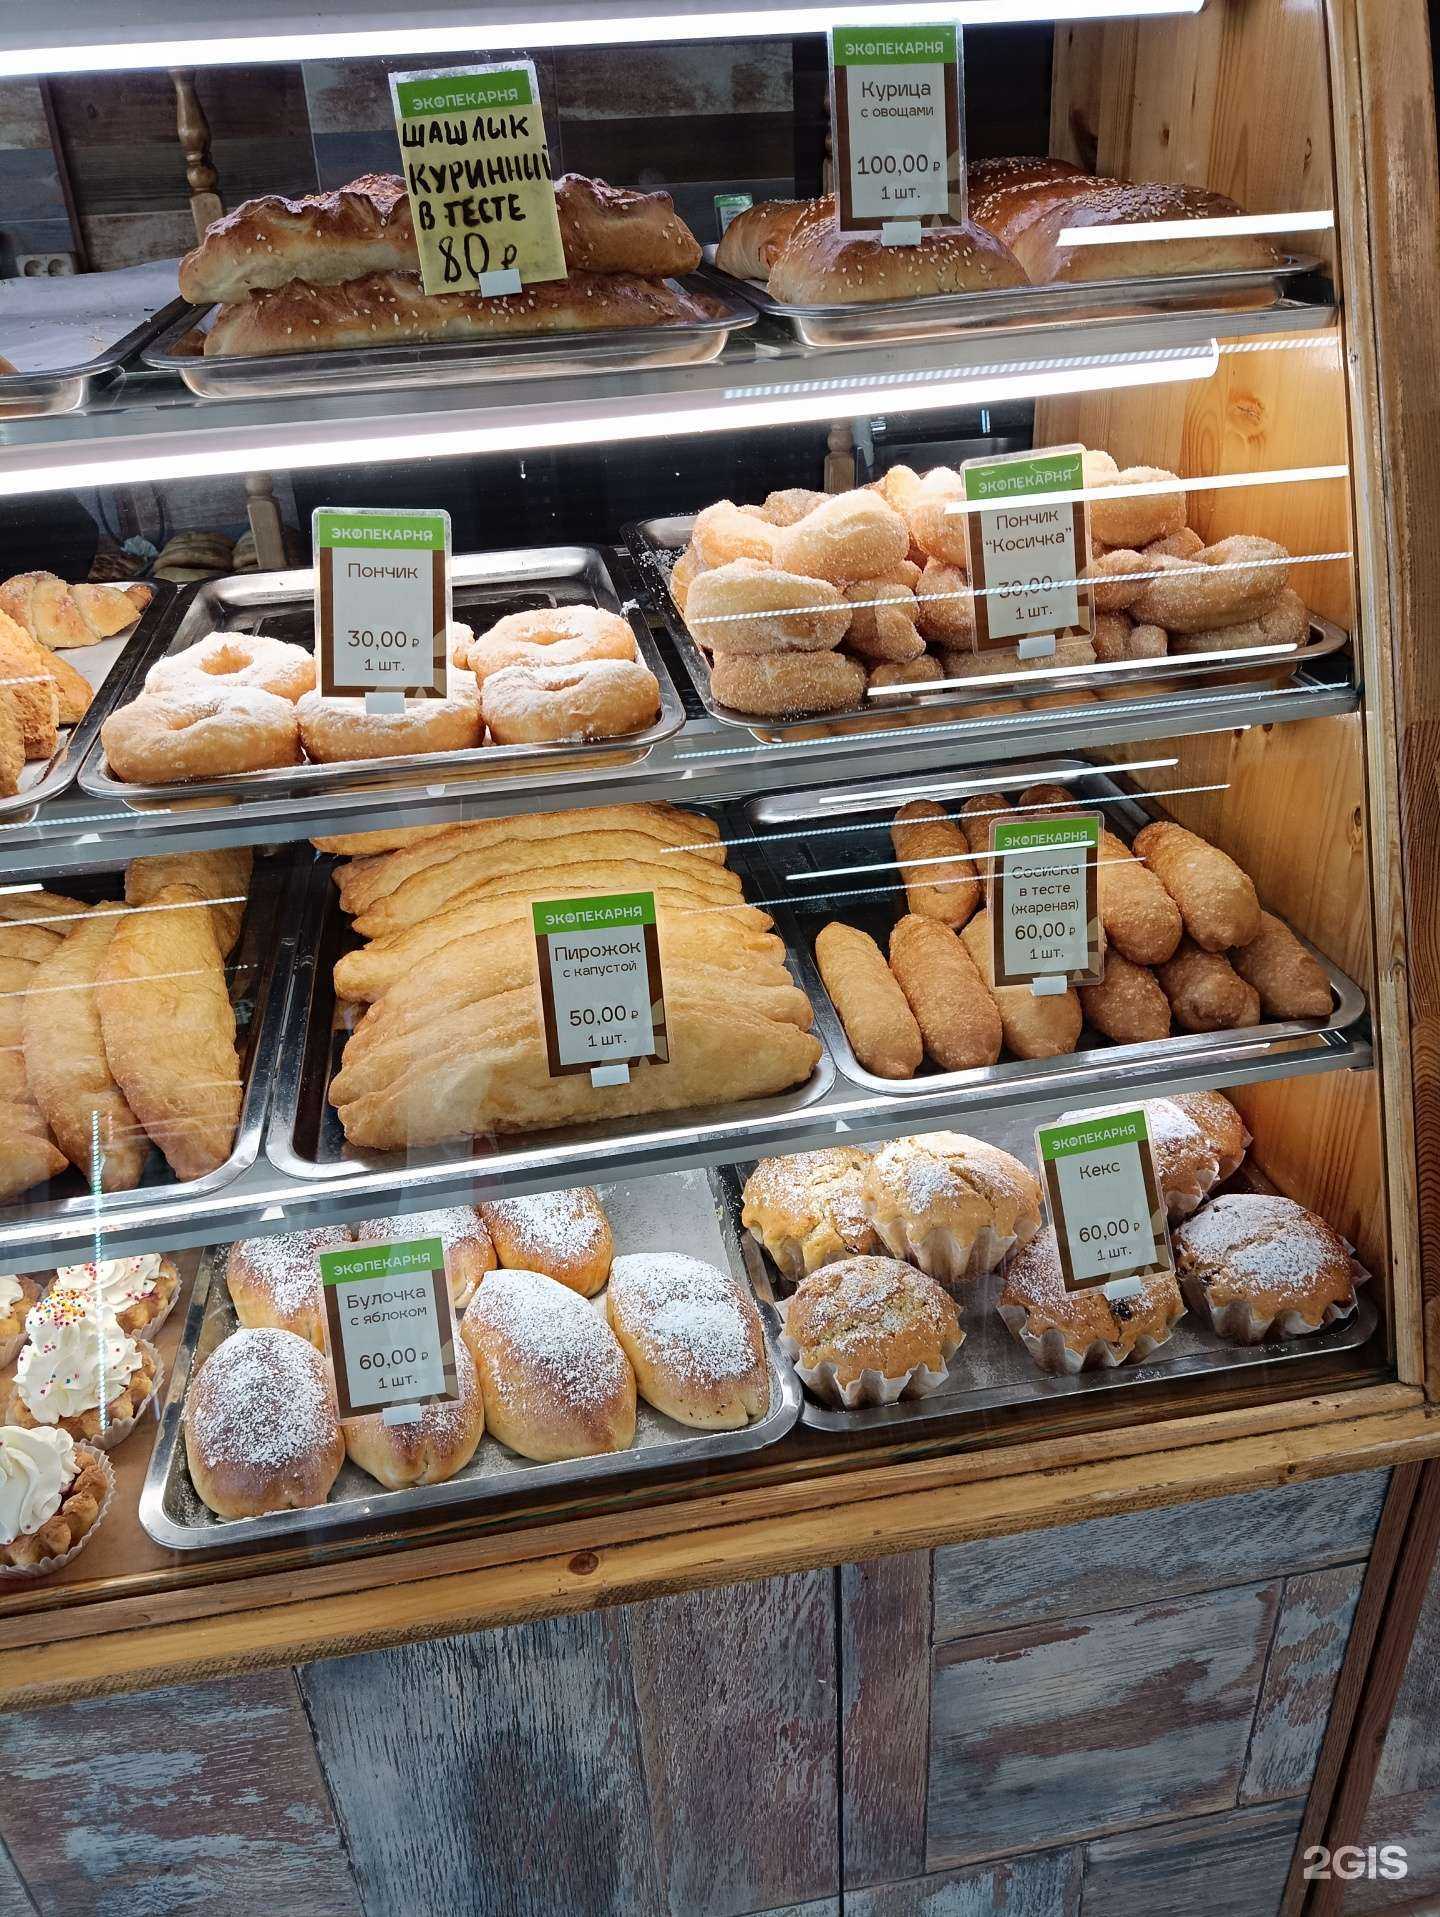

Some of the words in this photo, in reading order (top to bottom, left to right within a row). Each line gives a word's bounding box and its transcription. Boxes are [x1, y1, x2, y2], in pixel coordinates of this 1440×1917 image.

[845, 41, 944, 56] ЭКОПЕКАРНЯ
[412, 88, 519, 111] ЭКОПЕКАРНЯ
[861, 81, 931, 102] Курица
[860, 107, 869, 118] с
[872, 106, 934, 118] овощами
[402, 114, 529, 148] ШАШЛЫК
[857, 154, 929, 176] 100,00
[881, 187, 890, 200] 1
[894, 185, 921, 199] шт.
[418, 200, 436, 231] В
[444, 193, 527, 228] ТЕСТЕ
[438, 232, 490, 283] 80
[976, 469, 1073, 493] ЭКОПЕКАРНЯ
[996, 509, 1060, 530] Пончик
[331, 528, 434, 542] ЭКОПЕКАРНЯ
[348, 562, 419, 579] Пончик
[1015, 608, 1025, 620] 1
[1028, 604, 1054, 618] шт.
[347, 630, 407, 651] 30,00
[364, 658, 373, 671] 1
[378, 660, 405, 672] шт.
[1004, 830, 1089, 847] ЭКОПЕКАРНЯ
[1012, 864, 1080, 880] Сосиска
[1019, 889, 1028, 897] в
[1031, 884, 1071, 896] тесте
[545, 906, 644, 926] ЭКОПЕКАРНЯ
[1011, 899, 1080, 916] (жареная)
[1015, 922, 1066, 942] 60,00
[555, 942, 642, 963] Пирожок
[1029, 949, 1038, 960] 1
[1041, 947, 1065, 960] шт.
[563, 969, 571, 978] с
[574, 961, 638, 978] капустой
[569, 1005, 627, 1027] 50,00
[588, 1036, 598, 1048] 1
[601, 1034, 628, 1046] шт.
[1052, 1124, 1138, 1151] ЭКОПЕКАРНЯ
[1079, 1161, 1122, 1180] Кекс
[1079, 1218, 1131, 1243] 60,00
[1097, 1250, 1106, 1261] 1
[1108, 1246, 1133, 1259] шт.
[333, 1252, 431, 1276] ЭКОПЕКАРНЯ
[347, 1287, 427, 1311] Булочка
[350, 1317, 359, 1326] с
[364, 1307, 428, 1324] яблоком
[359, 1347, 417, 1370] 60,00
[378, 1377, 387, 1389] 1
[391, 1373, 418, 1387] шт.
